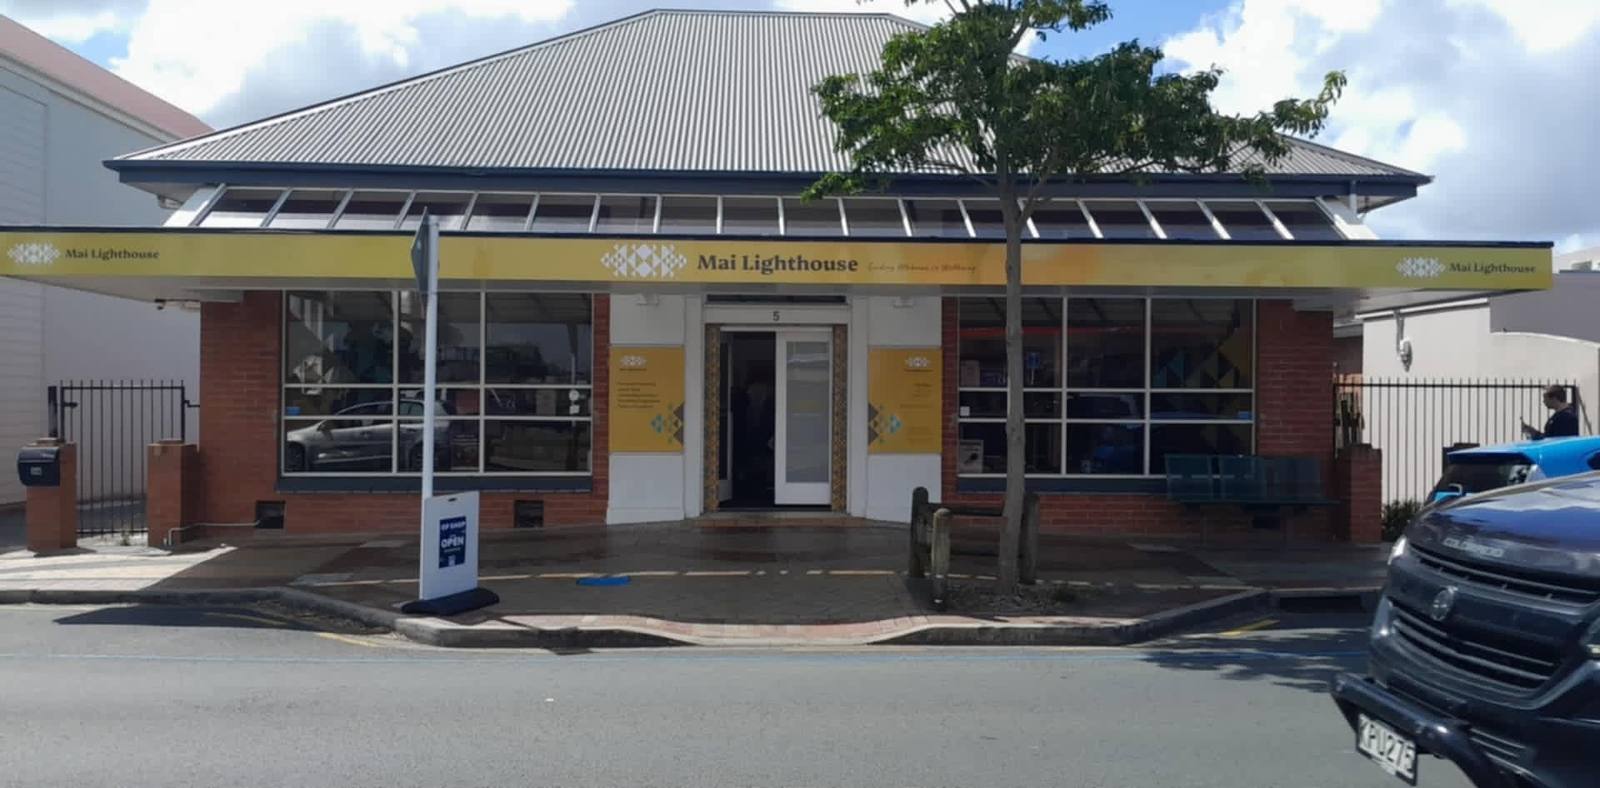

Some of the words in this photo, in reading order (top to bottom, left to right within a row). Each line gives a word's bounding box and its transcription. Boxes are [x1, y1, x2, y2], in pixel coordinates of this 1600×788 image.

[65, 248, 89, 259] Mai
[91, 247, 160, 261] Lighthouse
[697, 254, 737, 271] Mai
[741, 253, 858, 276] Lighthouse
[1449, 262, 1471, 272] Mai
[1473, 262, 1536, 275] Lighthouse
[772, 311, 780, 322] 5
[441, 537, 465, 549] OPEN
[1359, 719, 1415, 774] KPU275
